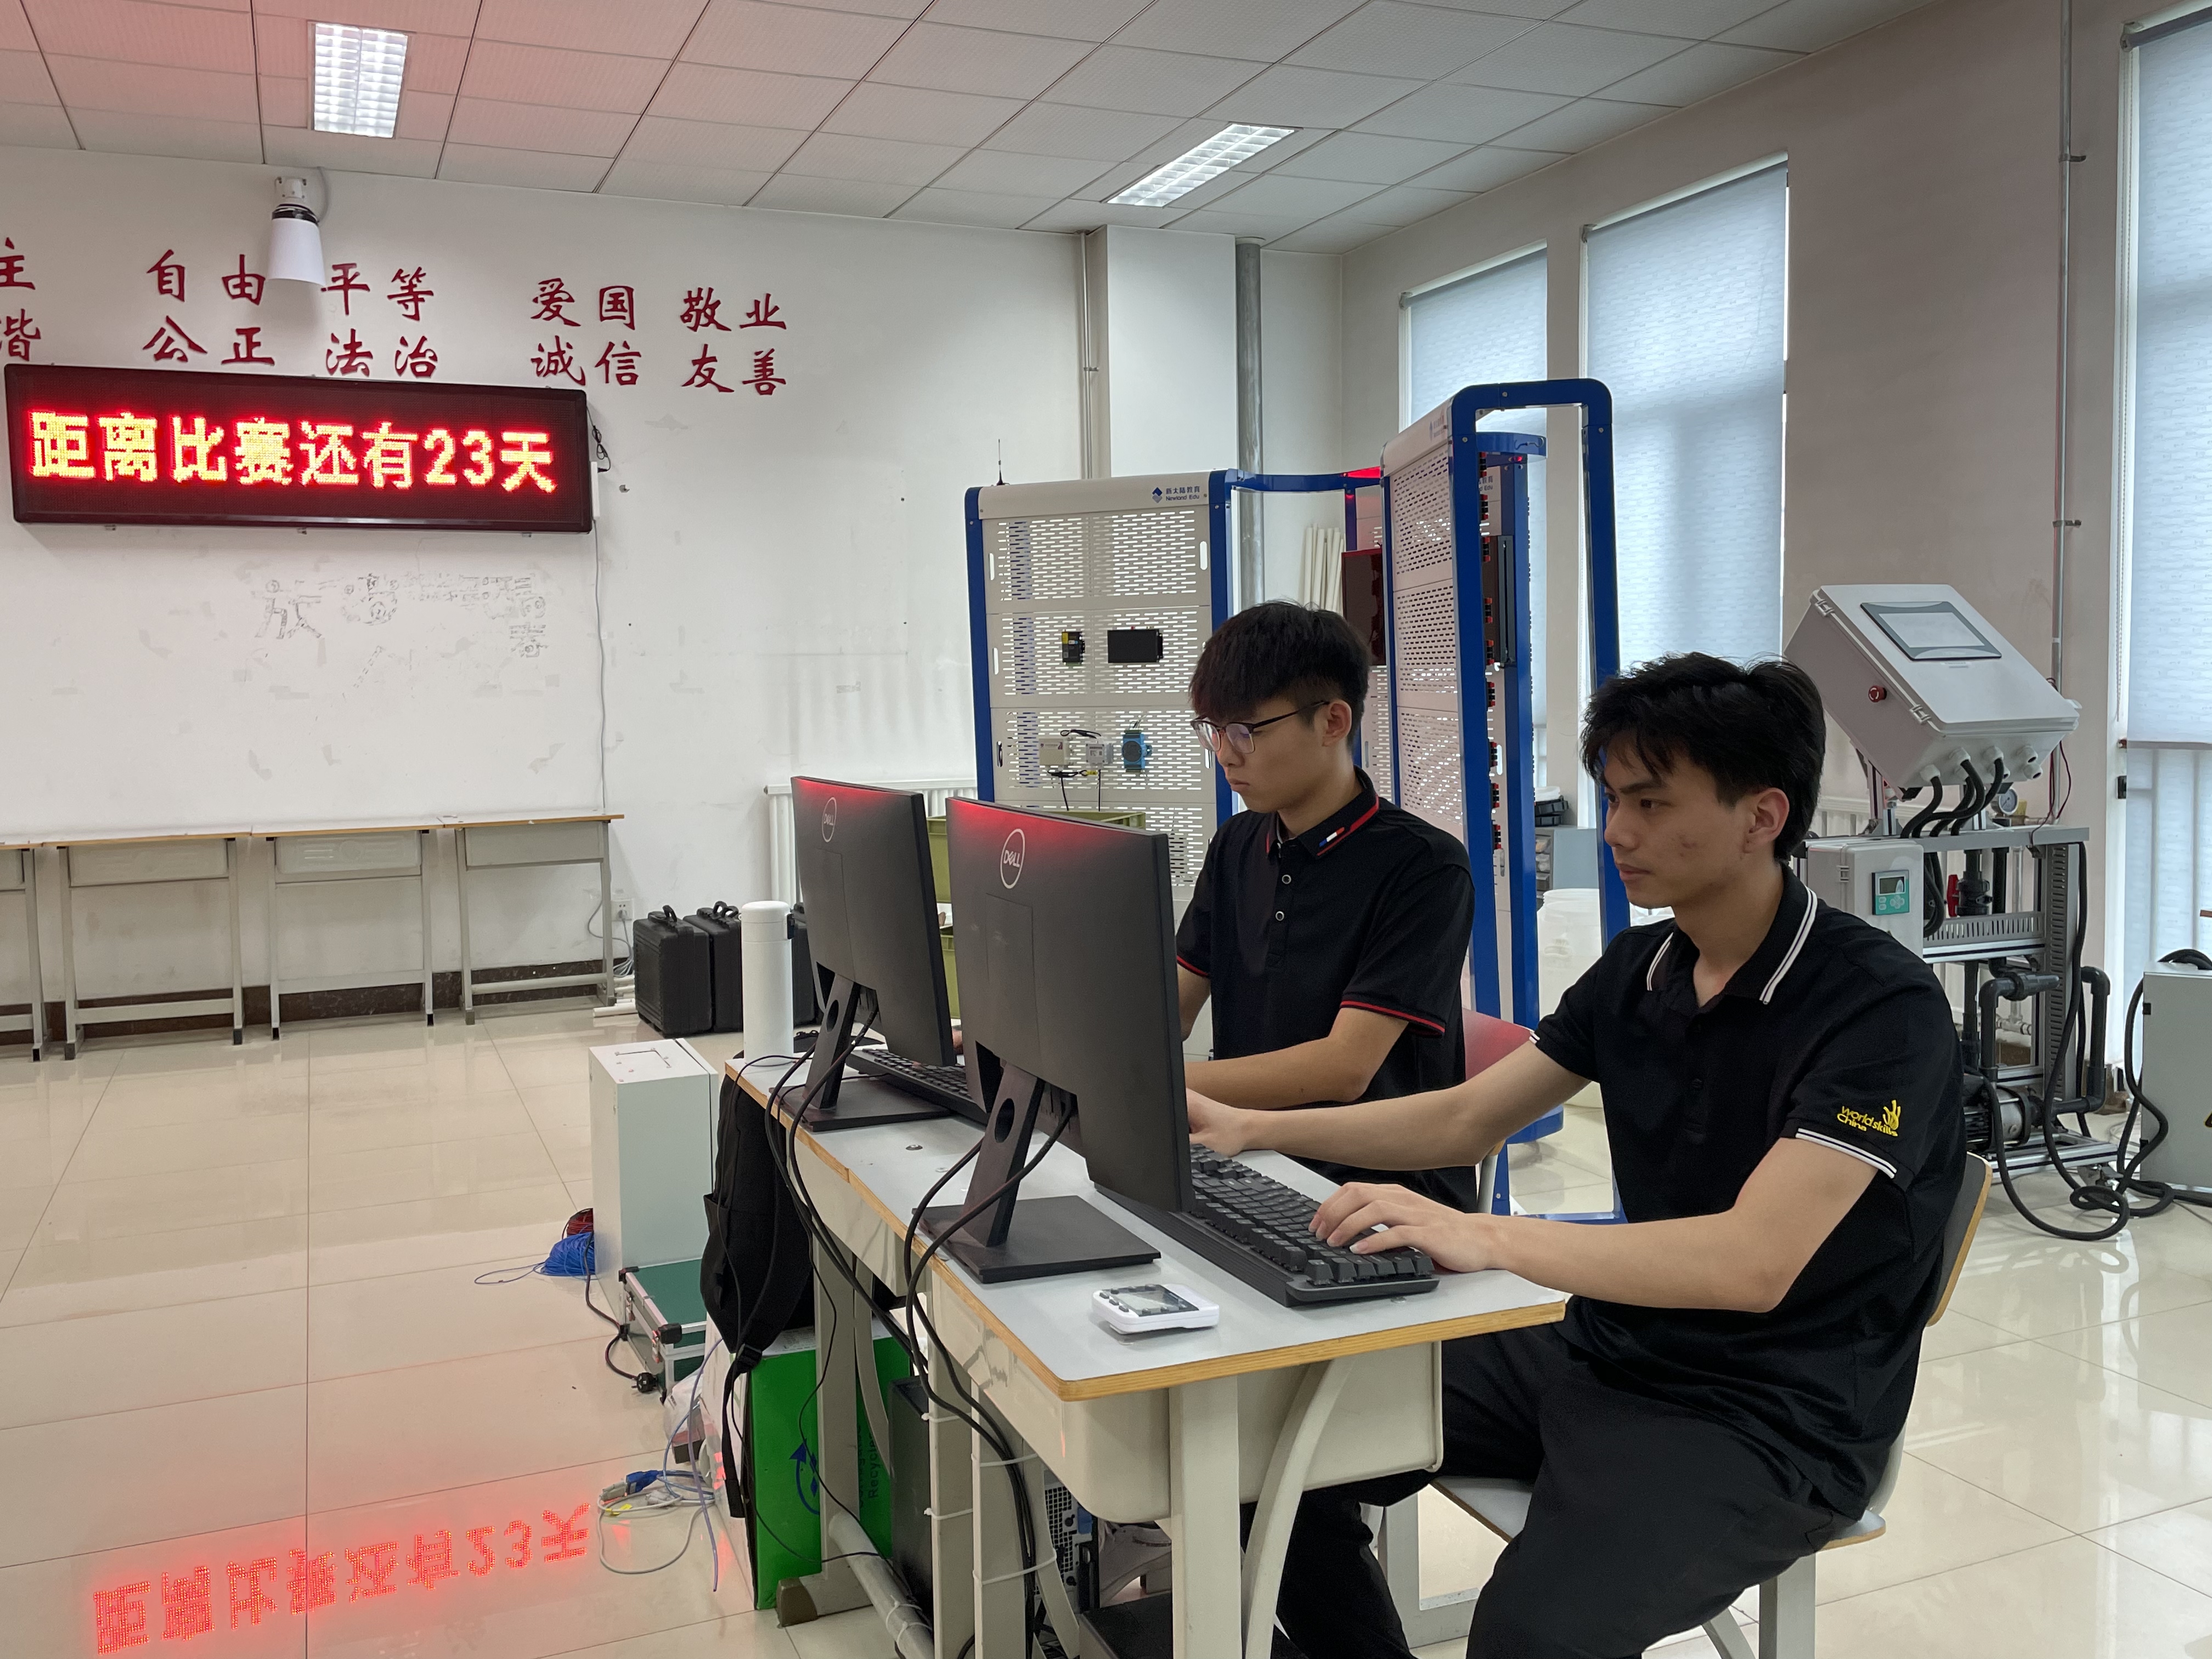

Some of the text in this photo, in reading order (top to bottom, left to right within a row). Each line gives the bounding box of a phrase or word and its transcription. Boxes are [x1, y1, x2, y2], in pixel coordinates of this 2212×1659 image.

[146, 249, 266, 306] 自由
[321, 263, 434, 321] 平等
[531, 277, 635, 330] 爱国
[680, 287, 787, 332] 敬业
[143, 315, 275, 365] 公正
[325, 328, 439, 379] 法治
[531, 335, 642, 386] 诚信
[682, 343, 787, 396] 友善
[29, 408, 558, 495] 距离比赛还有23天
[823, 813, 834, 826] DELL
[1003, 850, 1020, 868] DELL
[1837, 1113, 1867, 1132] China
